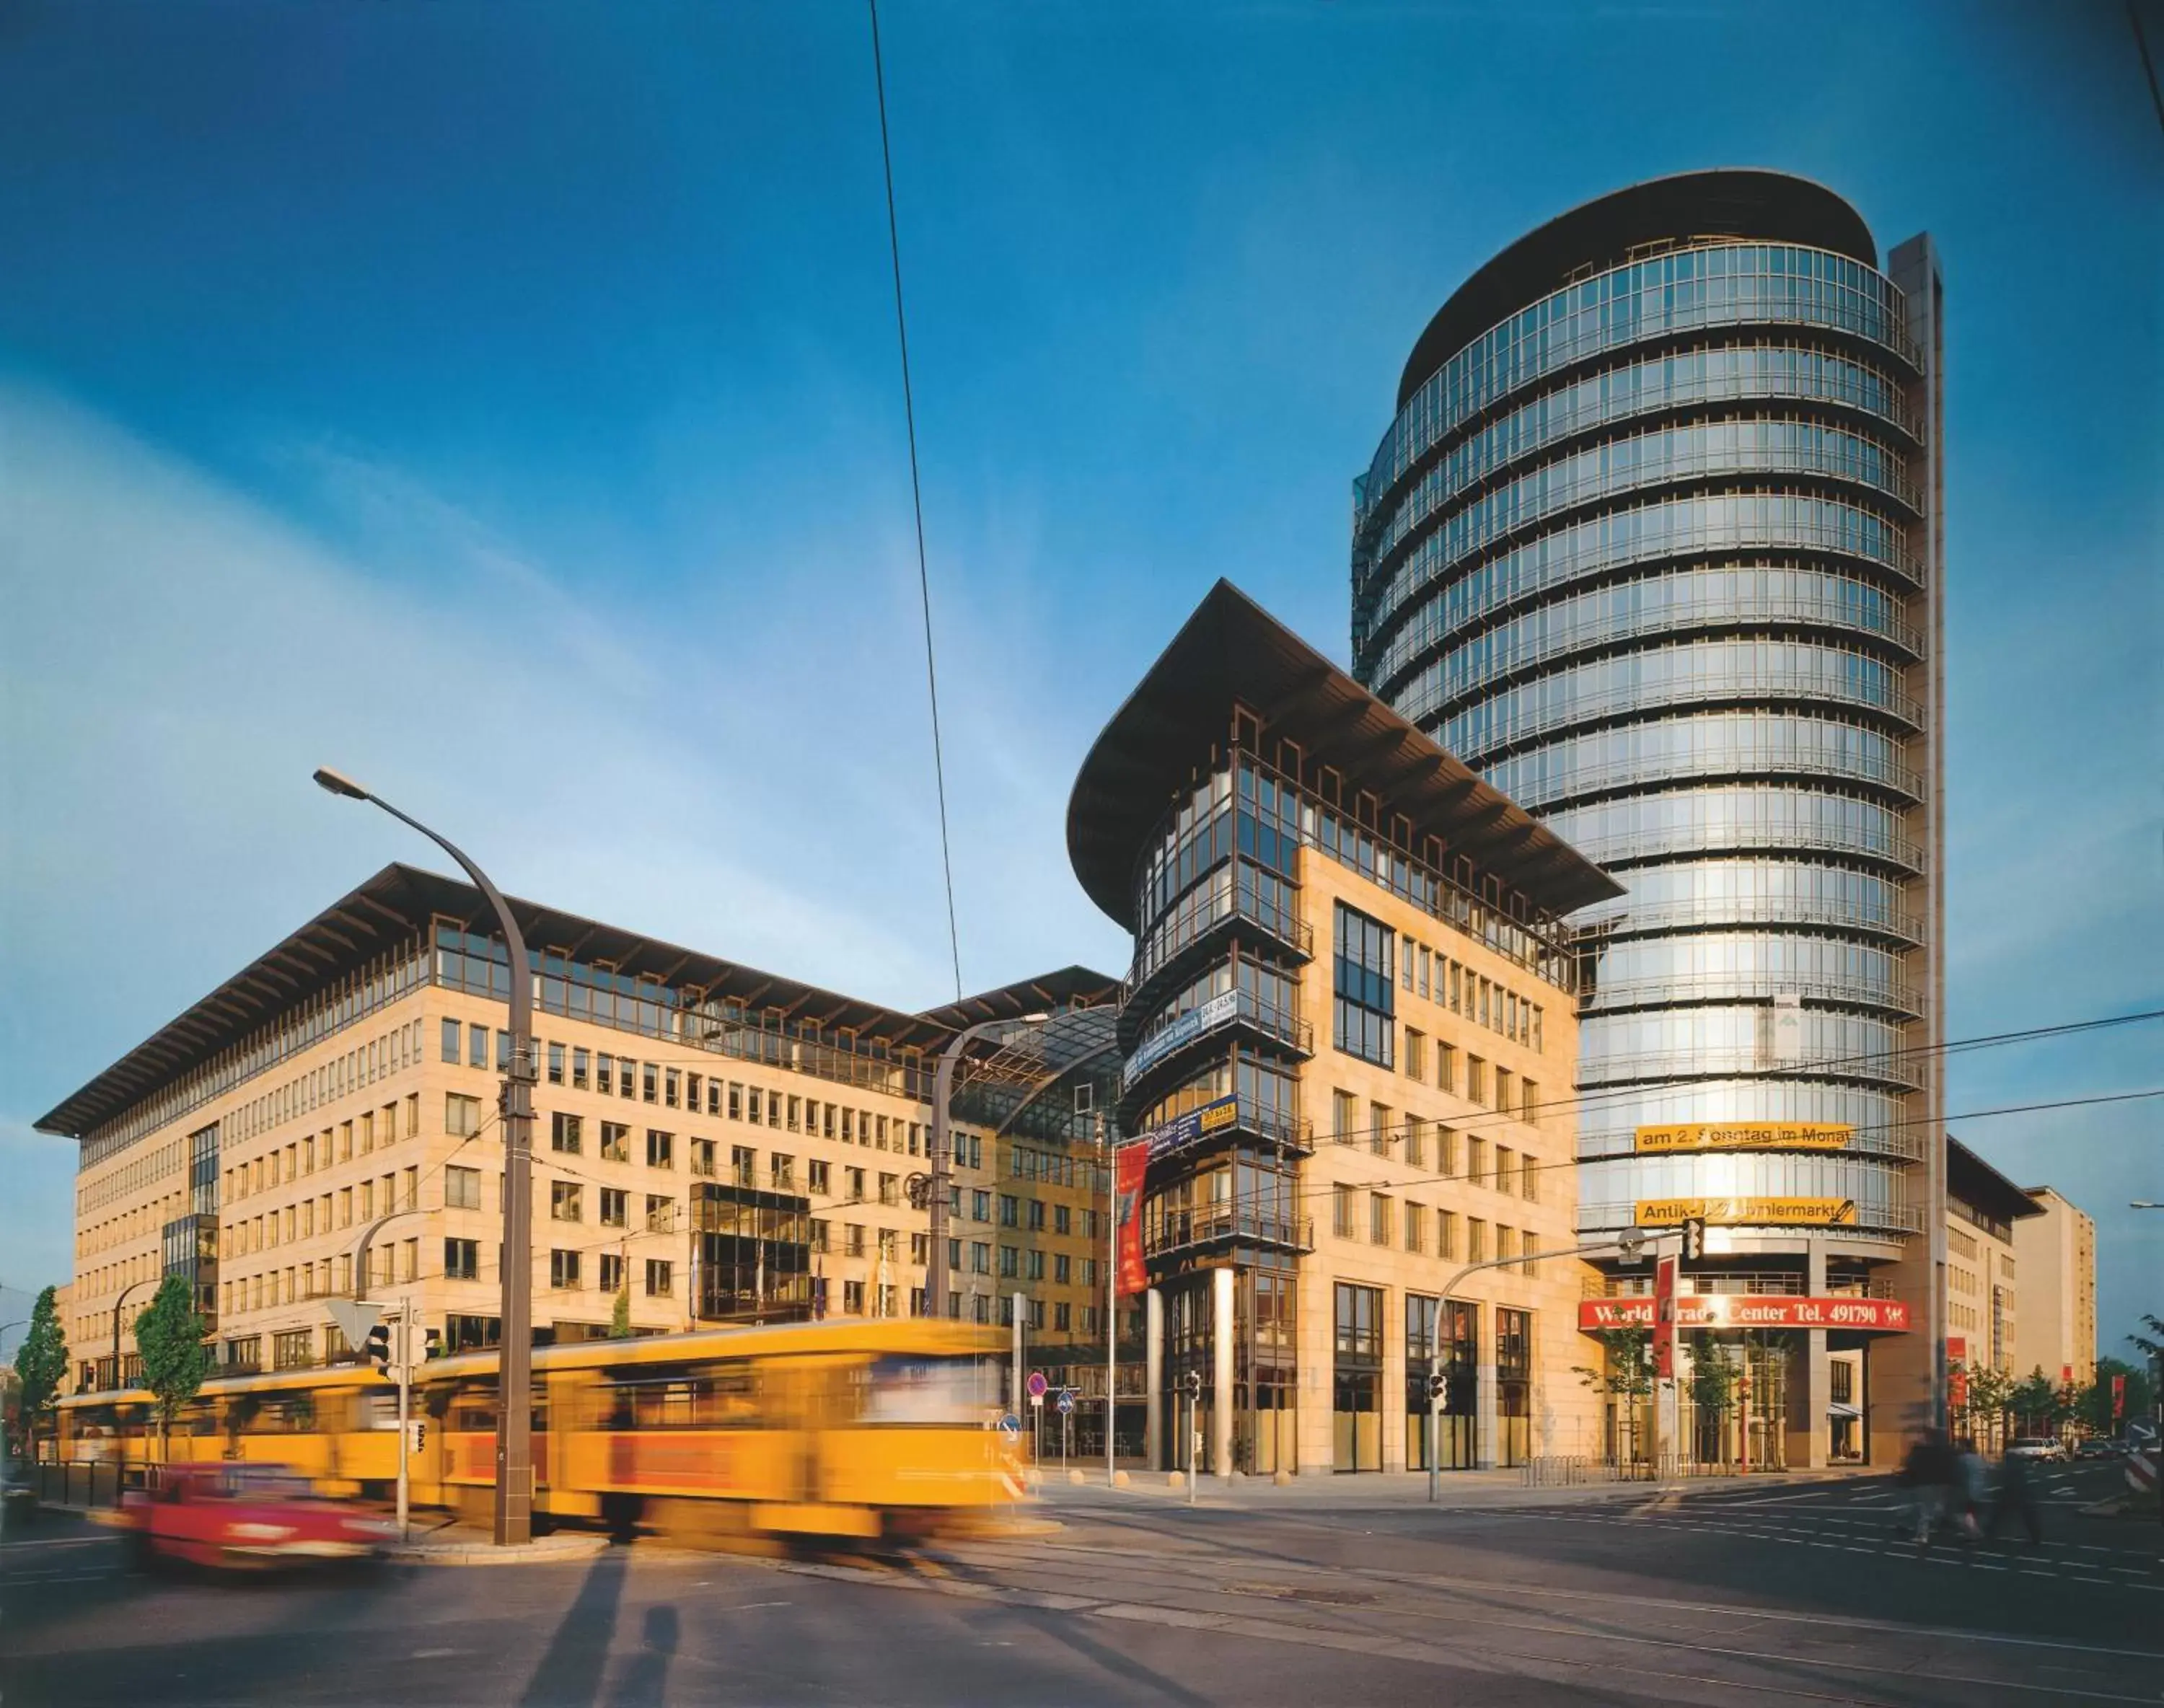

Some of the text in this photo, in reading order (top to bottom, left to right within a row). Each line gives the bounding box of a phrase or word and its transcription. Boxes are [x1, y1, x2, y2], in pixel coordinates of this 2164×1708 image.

[1643, 1133, 1671, 1145] am
[1677, 1130, 1693, 1143] 2.
[1777, 1126, 1797, 1139] im
[1802, 1127, 1849, 1143] Monat
[1644, 1204, 1697, 1218] Antik-
[1729, 1303, 1788, 1321] Center
[1793, 1303, 1825, 1322] Tel.
[1829, 1304, 1877, 1324] 491790
